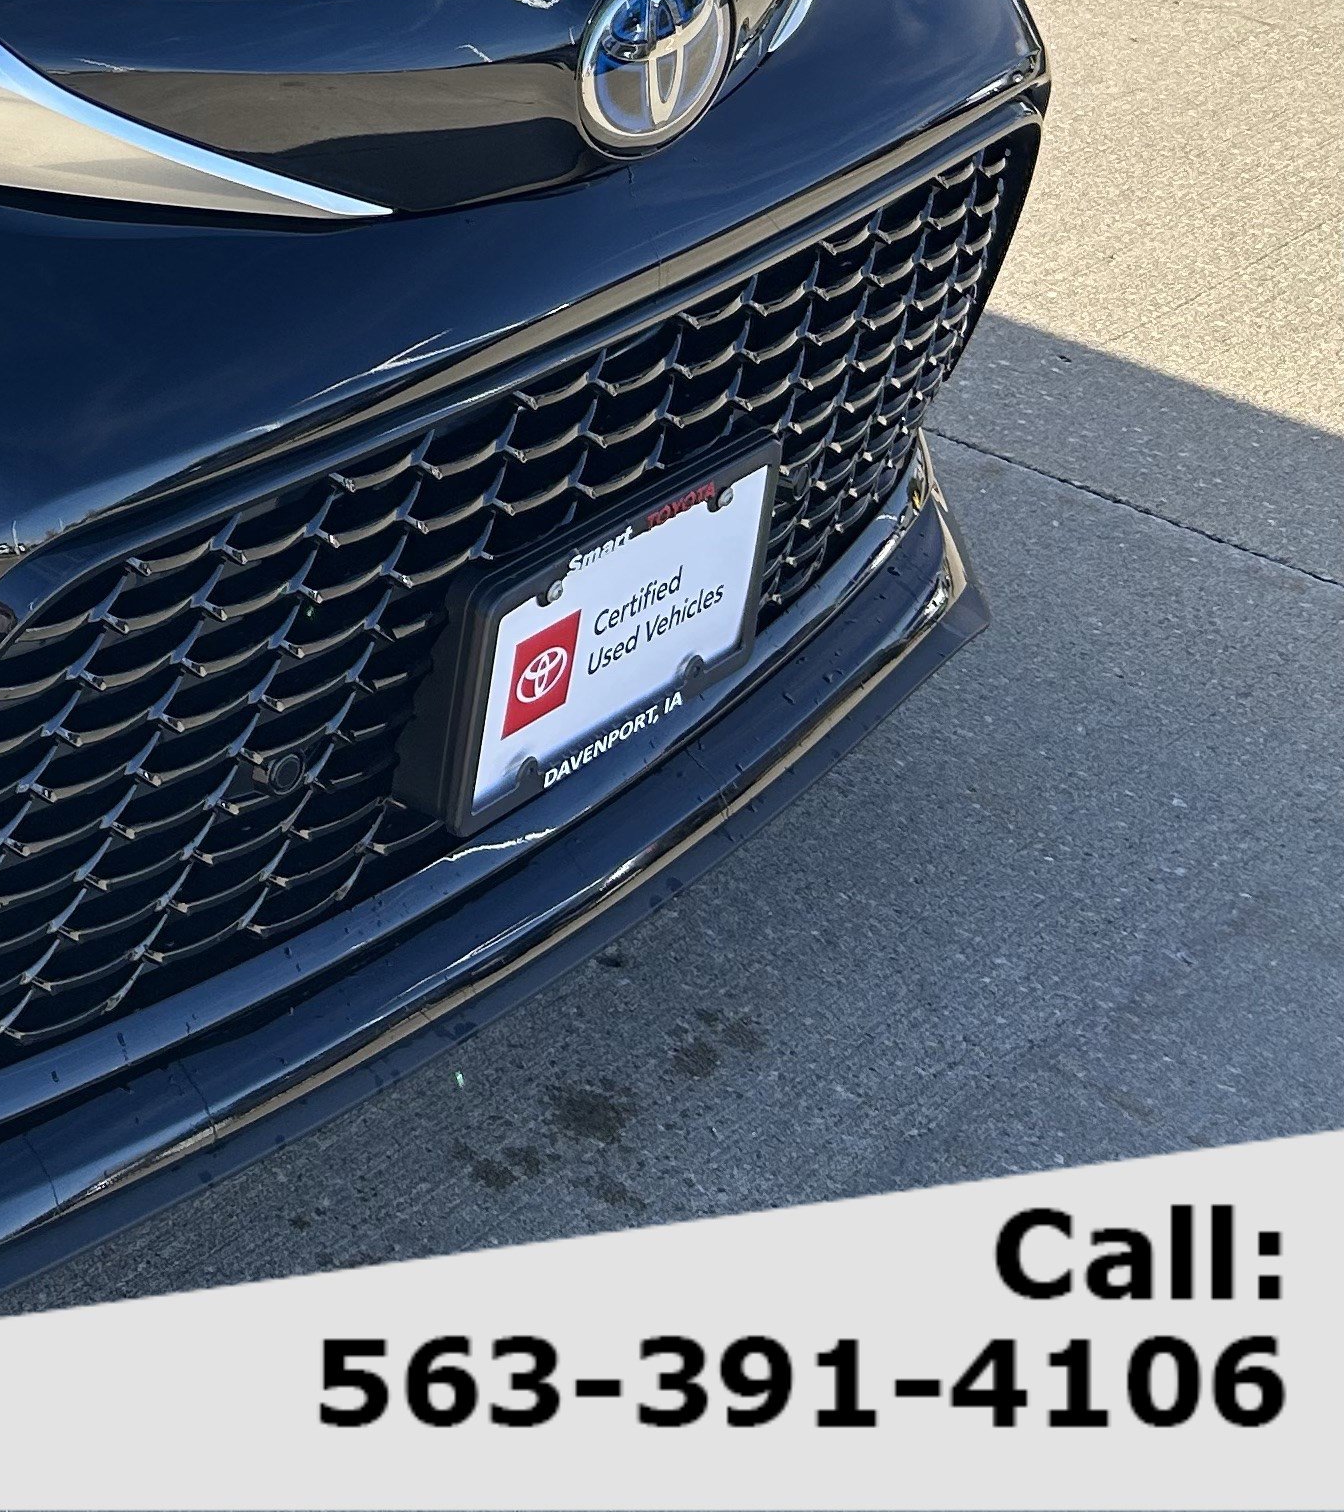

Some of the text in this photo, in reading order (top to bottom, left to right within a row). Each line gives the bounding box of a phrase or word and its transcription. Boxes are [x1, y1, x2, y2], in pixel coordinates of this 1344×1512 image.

[568, 481, 716, 571] Smart TOYOTA
[587, 584, 725, 676] Used Vehicles
[593, 564, 684, 636] Certified
[543, 691, 683, 789] DAVENPORT, IA
